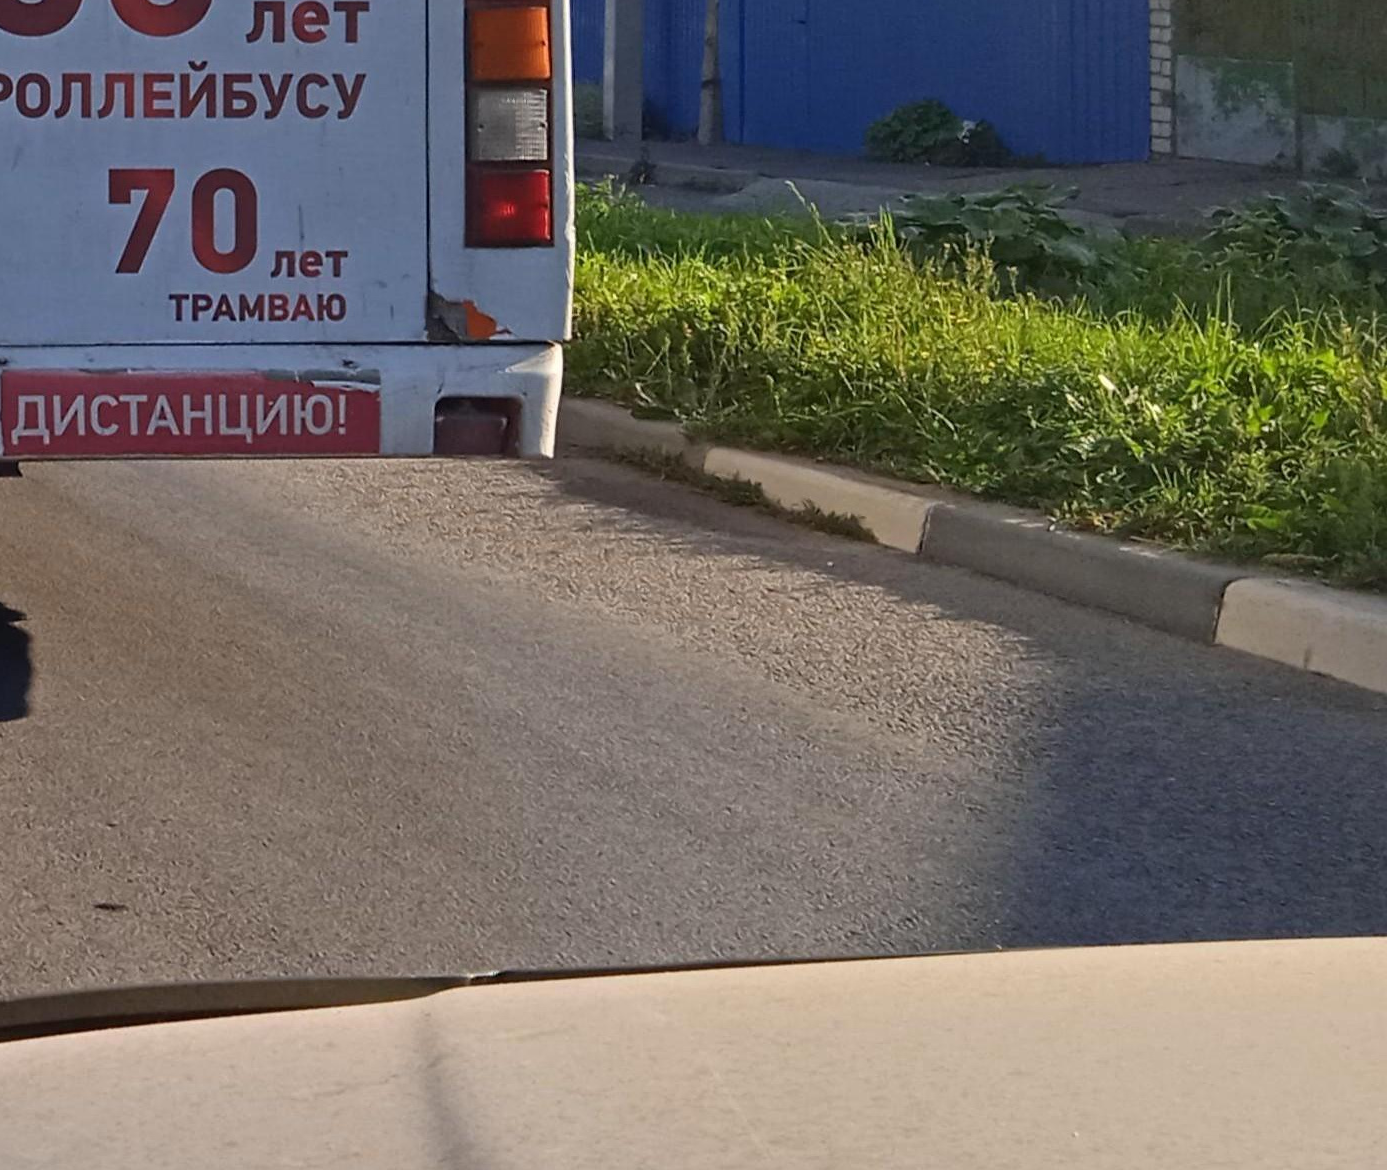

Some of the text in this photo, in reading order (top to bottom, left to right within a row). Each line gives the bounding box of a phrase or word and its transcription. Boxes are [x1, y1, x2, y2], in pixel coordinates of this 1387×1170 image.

[245, 0, 370, 44] лет
[108, 168, 349, 278] 70 лет
[168, 293, 347, 322] ТРАМВАЮ
[11, 394, 347, 445] ДИСТАНЦИЮ!
